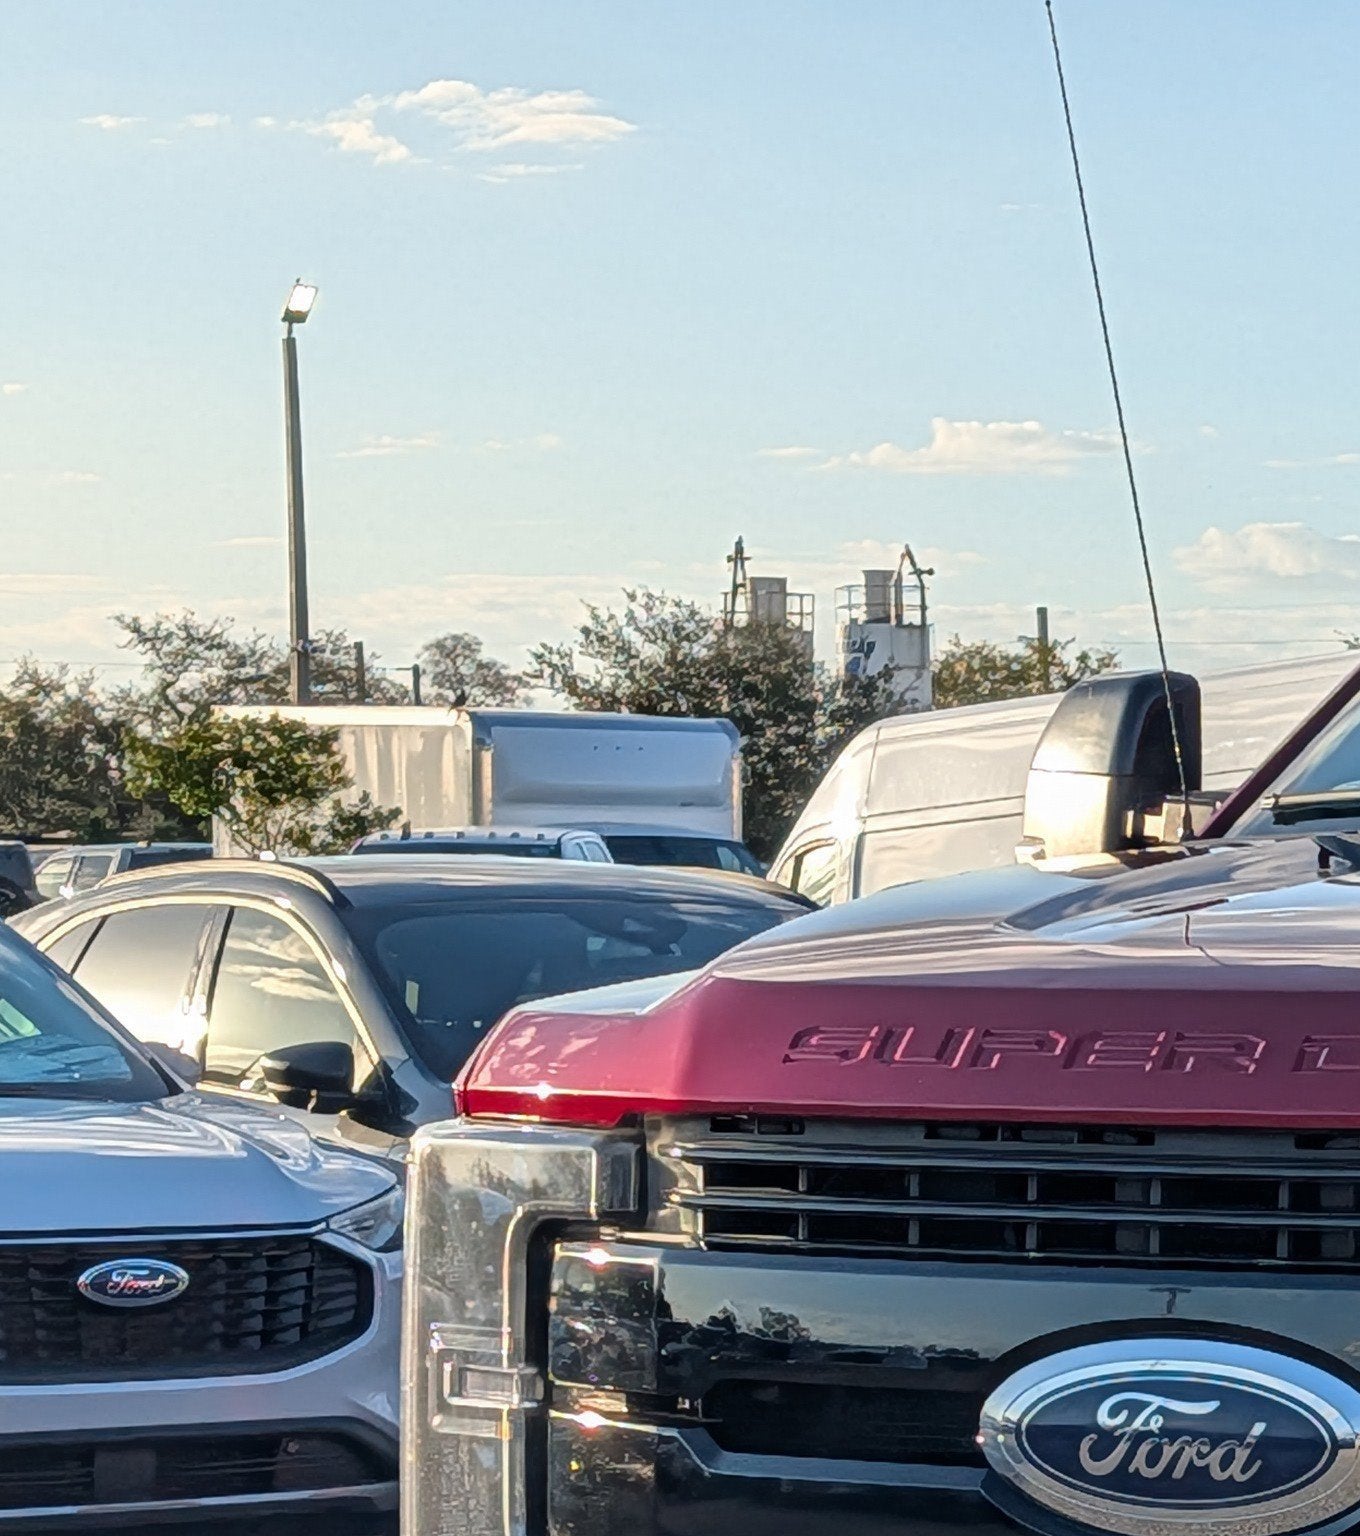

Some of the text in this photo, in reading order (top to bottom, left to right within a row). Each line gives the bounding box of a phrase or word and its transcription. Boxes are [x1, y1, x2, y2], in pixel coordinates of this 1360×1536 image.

[782, 1023, 1266, 1075] SUPER
[106, 1269, 166, 1295] Ford
[1078, 1391, 1267, 1483] Ford
